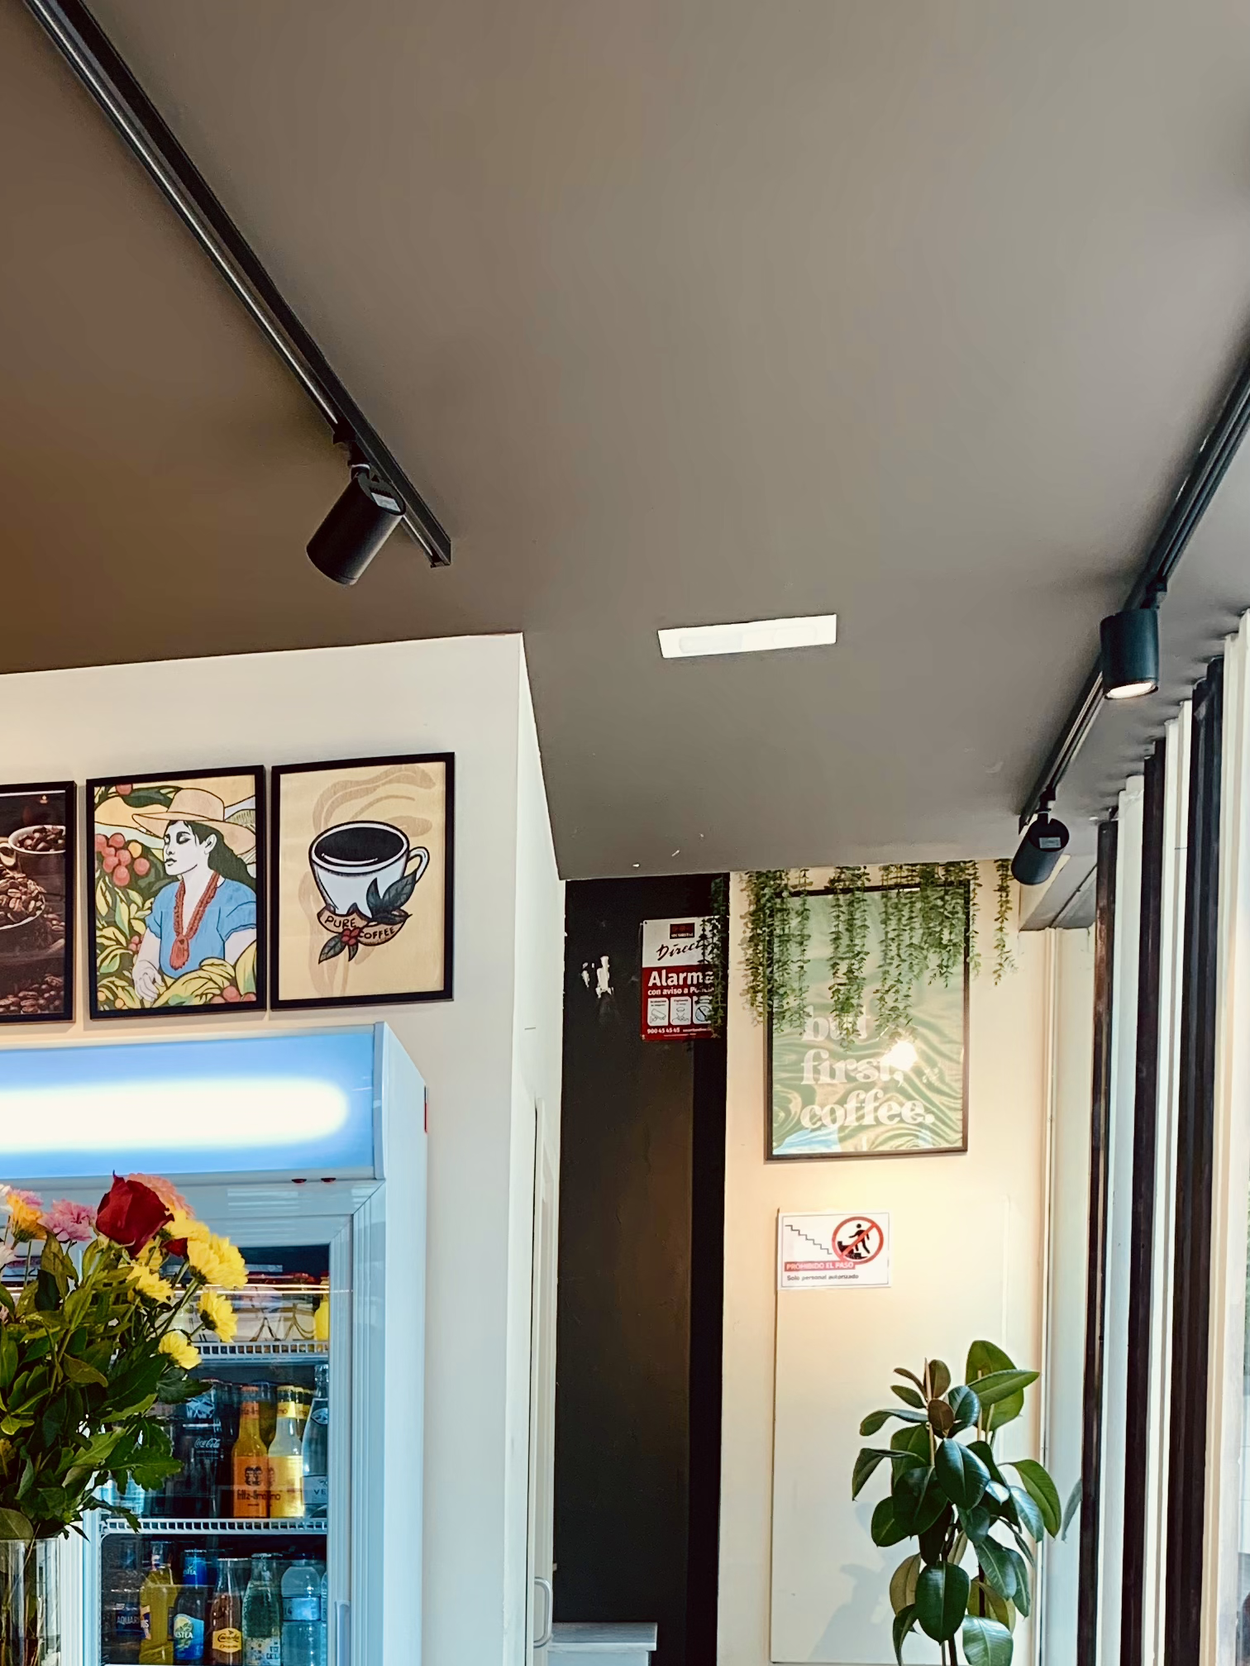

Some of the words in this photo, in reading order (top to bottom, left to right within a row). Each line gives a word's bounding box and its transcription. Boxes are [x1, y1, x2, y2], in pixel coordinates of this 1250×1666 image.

[324, 915, 357, 929] PURE
[358, 926, 396, 940] COFFEE
[647, 987, 662, 996] con
[662, 986, 682, 995] aviso
[800, 1088, 935, 1129] coffee.
[786, 1262, 825, 1271] PROHIBIDO
[835, 1261, 854, 1269] PASO
